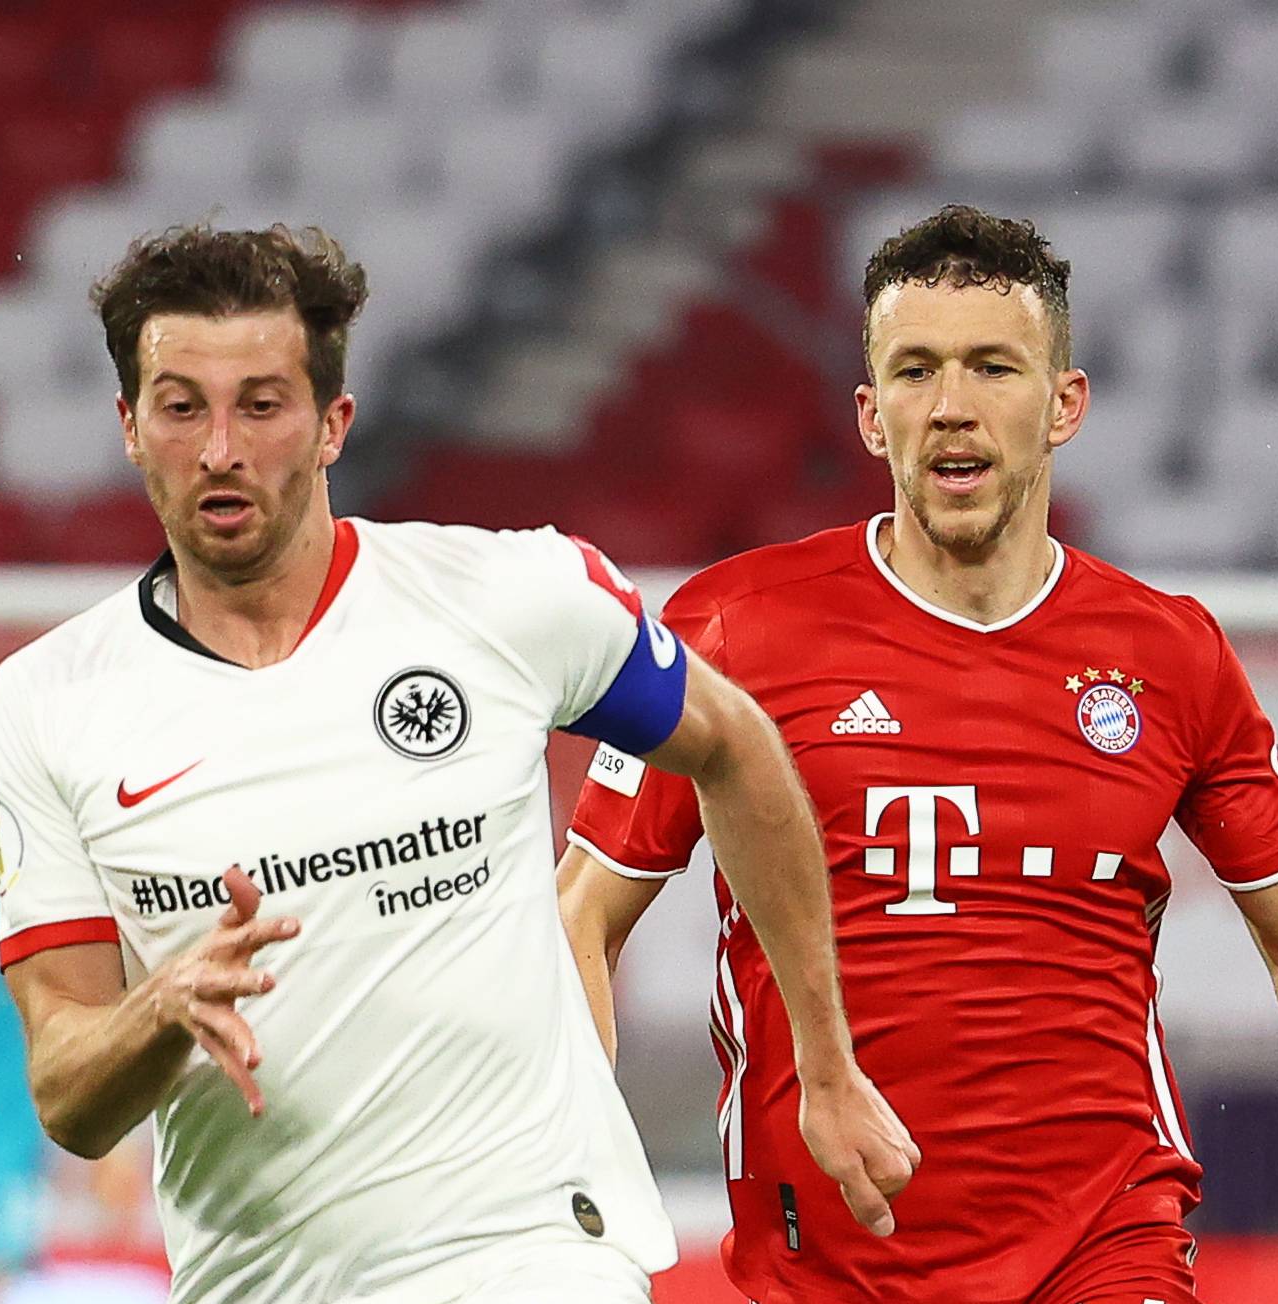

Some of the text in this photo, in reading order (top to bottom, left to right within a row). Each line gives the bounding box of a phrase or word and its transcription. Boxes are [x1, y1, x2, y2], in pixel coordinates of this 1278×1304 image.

[1092, 690, 1134, 716] BAYERN
[830, 717, 901, 735] adidas
[594, 750, 624, 774] 019
[865, 785, 980, 915] T
[375, 856, 491, 917] indeed
